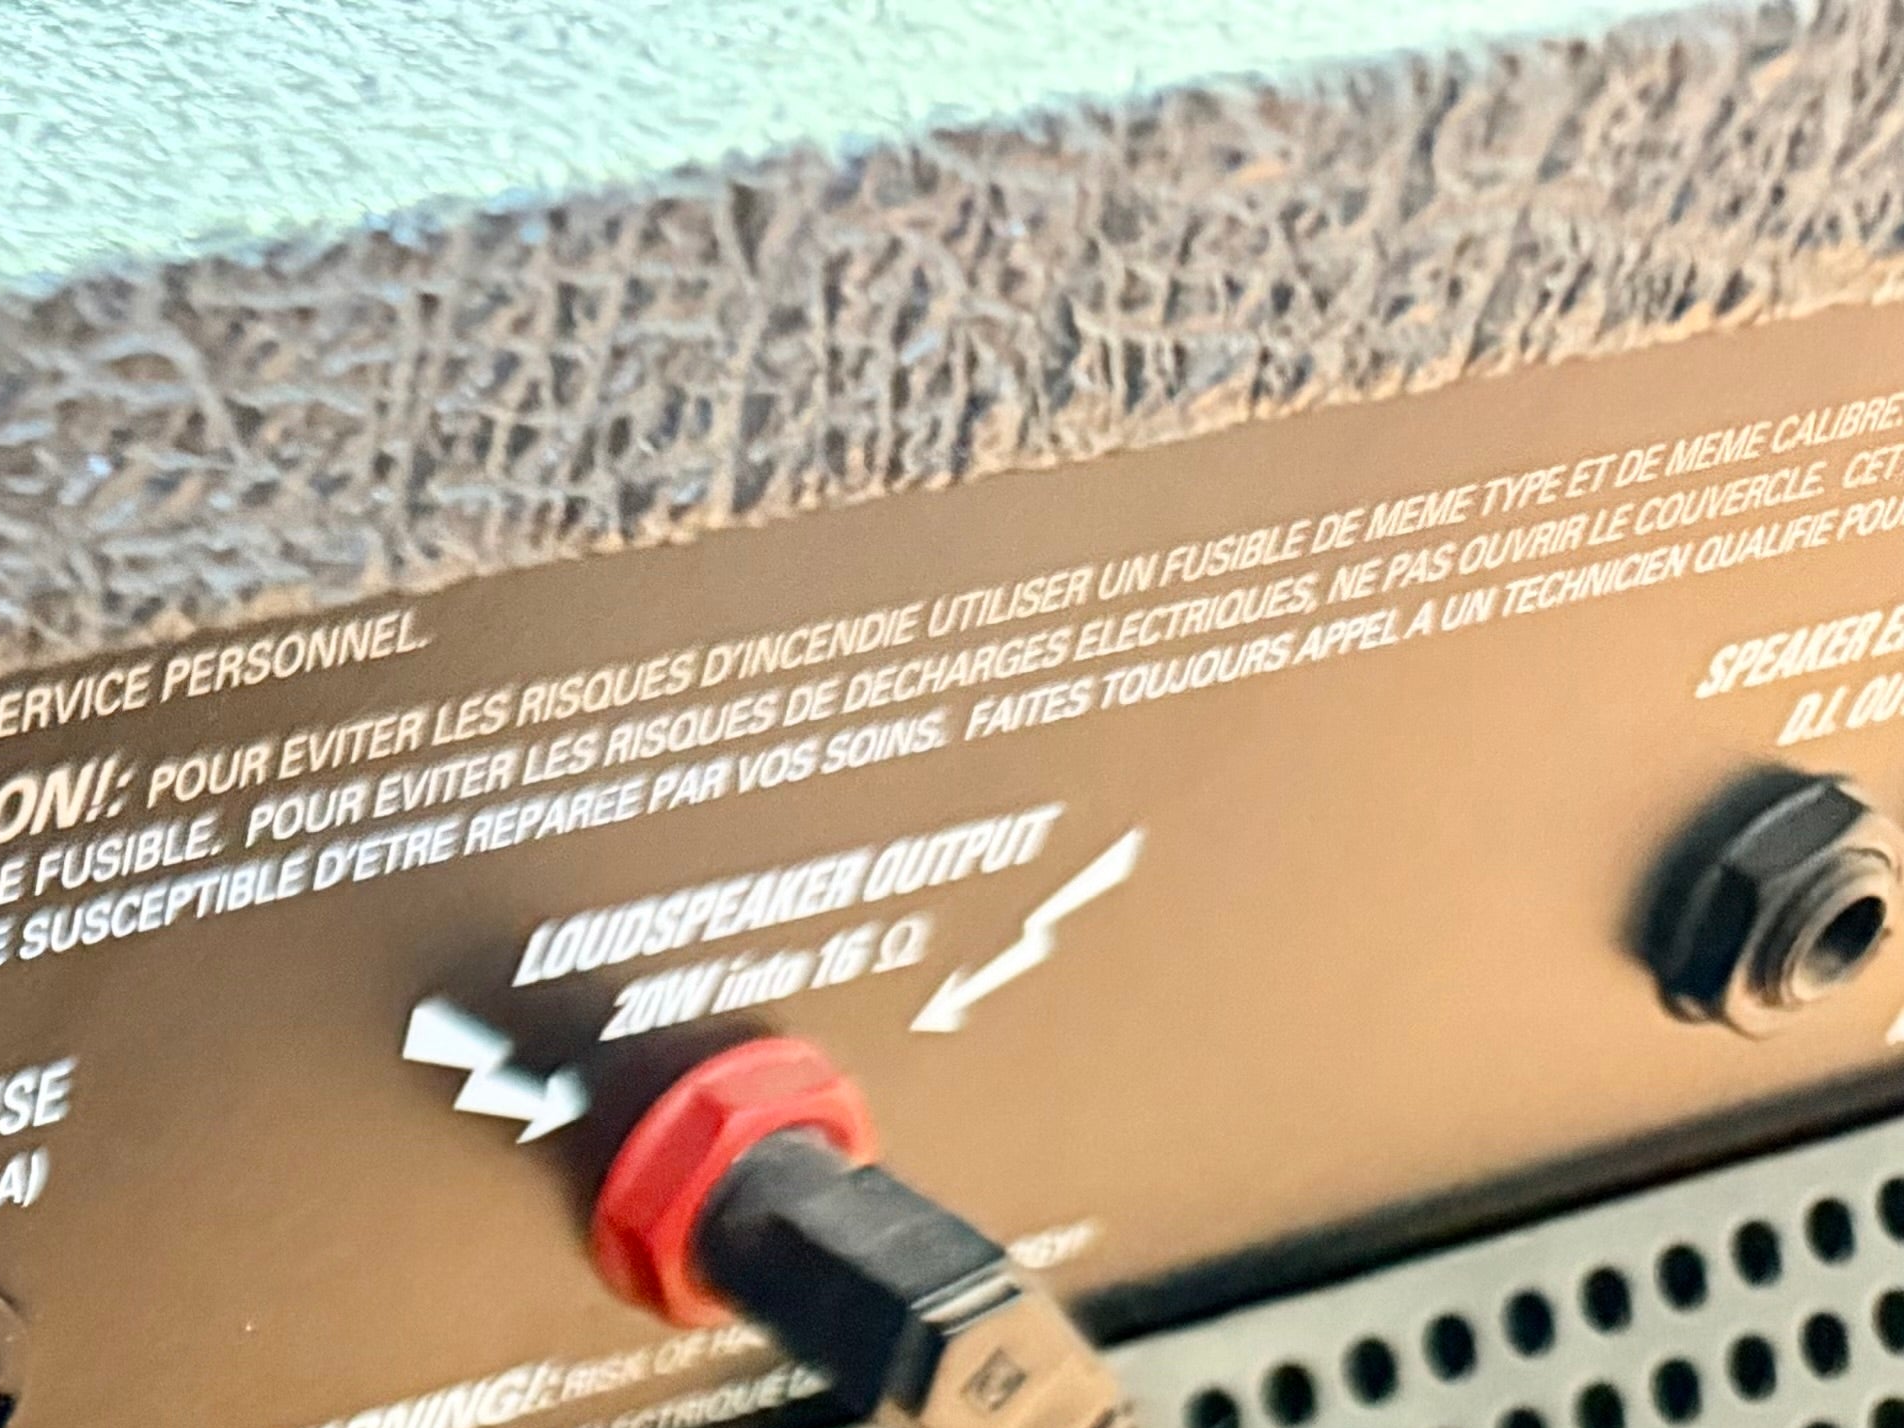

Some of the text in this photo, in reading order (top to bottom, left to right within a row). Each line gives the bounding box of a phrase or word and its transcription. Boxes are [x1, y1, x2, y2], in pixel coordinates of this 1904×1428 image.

[34, 810, 226, 896] FUSIBLE.
[244, 778, 374, 848] POUR
[372, 744, 521, 820] EVITER
[520, 727, 608, 786] LES
[602, 689, 784, 768] RISQUES
[781, 677, 842, 728] DE
[839, 624, 1076, 715] DECHARGES
[1071, 571, 1322, 662] ELECTRIQUES,
[1326, 556, 1383, 602] NE
[1381, 542, 1458, 594] PAS
[1458, 513, 1591, 575] OUVRIR
[1586, 503, 1637, 547] LE
[1842, 443, 1904, 489] CET
[146, 739, 275, 809] POUR
[277, 704, 431, 780] EVITER
[431, 689, 517, 746] LES
[515, 645, 699, 728] RISQUES
[698, 601, 925, 690] D'INCENDIE
[927, 564, 1095, 639] UTILISER
[1097, 552, 1159, 600] UN
[1158, 519, 1312, 589] FUSIBLE
[1310, 507, 1365, 554] DE
[1363, 483, 1480, 543] MEME
[1481, 465, 1569, 517] TYPE
[1564, 453, 1618, 498] ET
[1613, 443, 1667, 488] DE
[1664, 421, 1773, 476] MEME
[160, 608, 434, 703] PERSONNEL.
[1694, 609, 1884, 699] SPEAKER
[17, 853, 311, 962] SUSCEPTIBLE
[311, 820, 463, 892] D'ETRE
[462, 774, 649, 857] REPAREE
[645, 753, 737, 815] PAR
[736, 741, 820, 794] VOS
[820, 707, 952, 775] SOINS.
[963, 675, 1097, 742] FAITES
[1099, 631, 1297, 709] TOUJOURS
[1291, 608, 1402, 666] APPEL
[1399, 598, 1435, 641] A
[1440, 585, 1499, 632] UN
[1499, 541, 1698, 618] TECHNICIEN
[1694, 508, 1841, 574] QUALIFIE
[1835, 495, 1904, 542] POU
[1844, 671, 1904, 730] OU
[511, 801, 1068, 987] LOUDSPEAKER OUTPUT
[599, 953, 730, 1041] 20W
[710, 946, 816, 1014] into
[810, 919, 881, 991] 16
